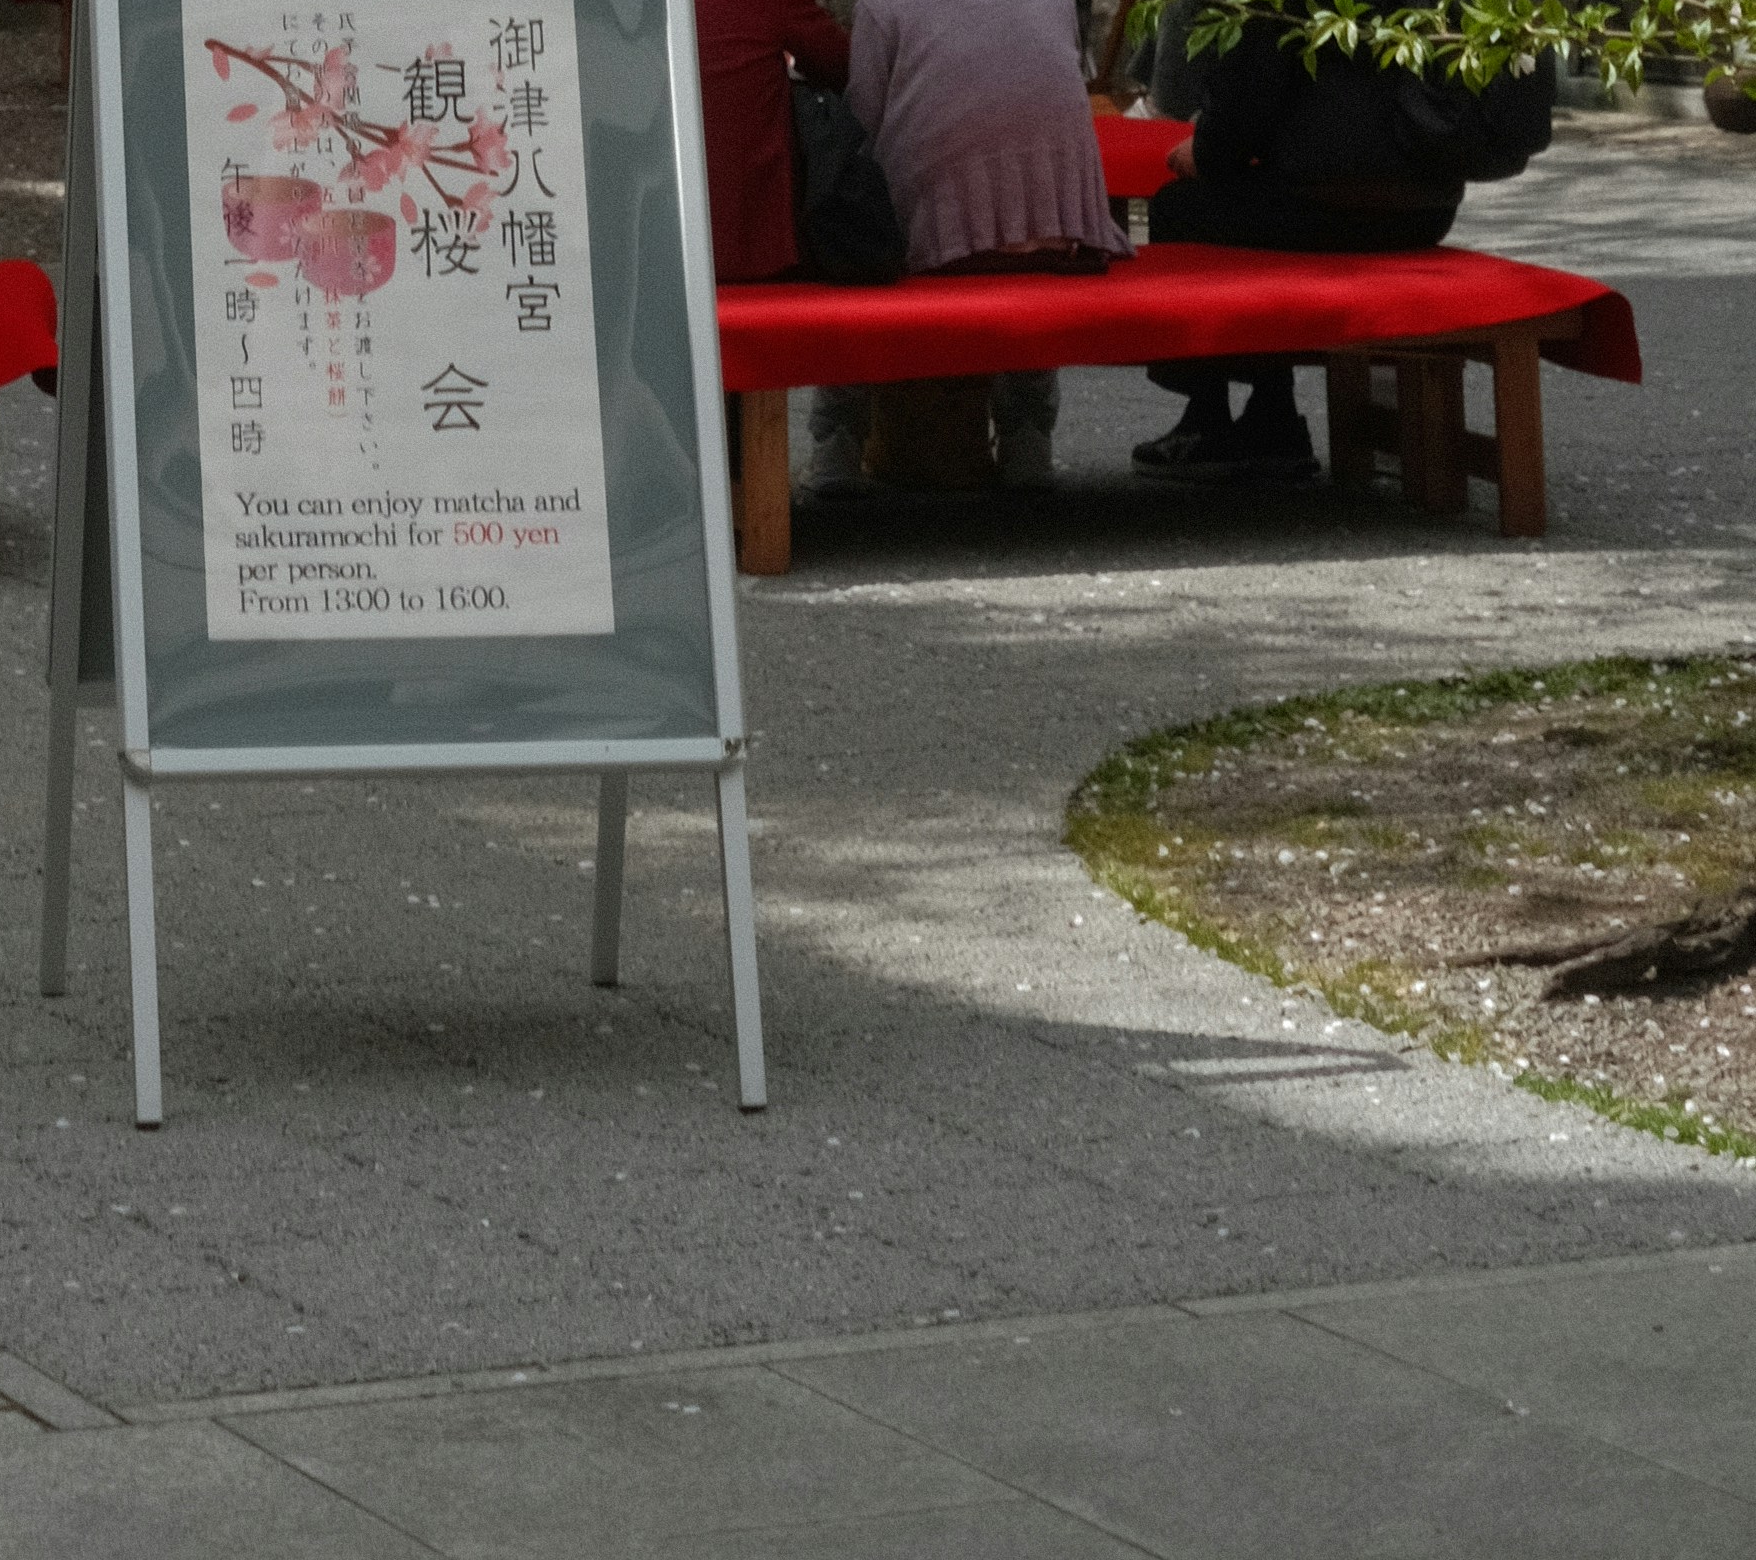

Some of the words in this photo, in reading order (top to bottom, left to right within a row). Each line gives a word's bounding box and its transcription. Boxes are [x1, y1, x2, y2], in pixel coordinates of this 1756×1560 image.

[489, 17, 561, 333] 御津八幡宮
[403, 56, 489, 432] 観桜会
[236, 491, 288, 516] You
[297, 497, 343, 516] can
[351, 490, 424, 518] enjoy
[433, 489, 525, 513] matcha
[534, 488, 581, 512] and
[235, 522, 397, 549] sakuramochi
[408, 522, 443, 546] for
[453, 521, 503, 546] 500
[513, 528, 560, 549] yen
[238, 563, 278, 584] per
[288, 562, 377, 584] person.
[238, 588, 309, 613] From
[322, 587, 390, 612] 13:00
[400, 589, 424, 611] to
[436, 585, 510, 610] 16:00.
